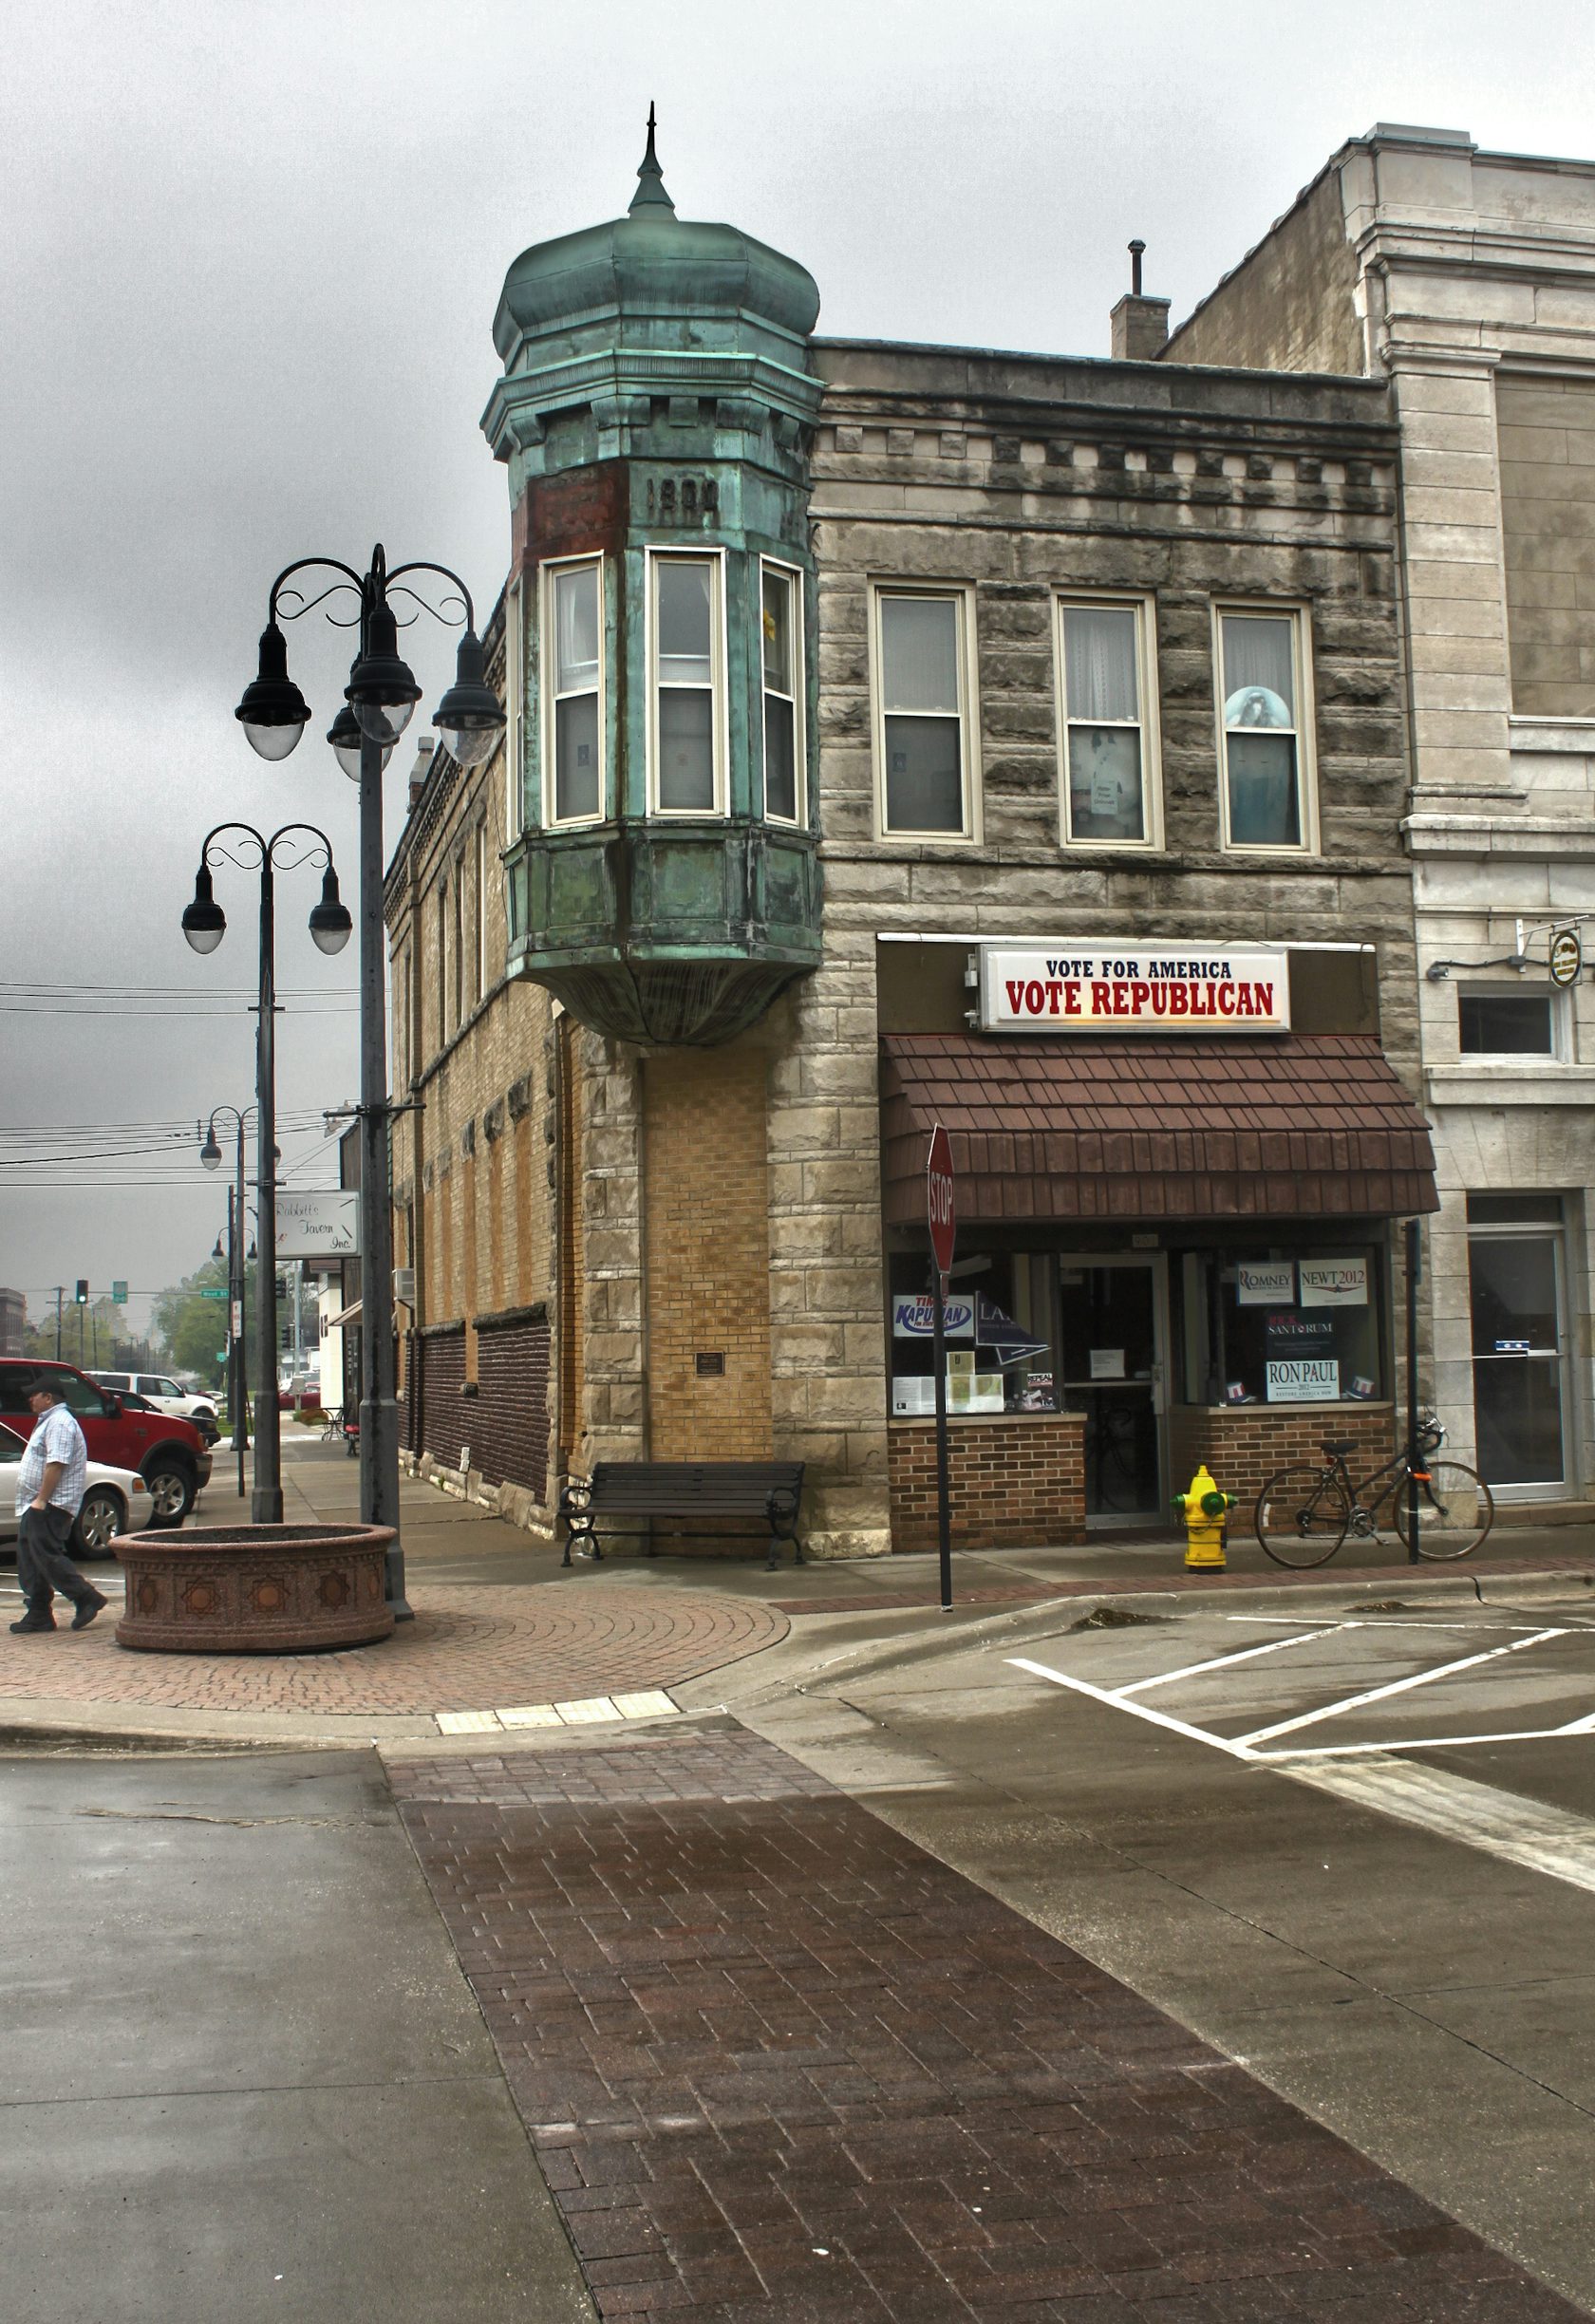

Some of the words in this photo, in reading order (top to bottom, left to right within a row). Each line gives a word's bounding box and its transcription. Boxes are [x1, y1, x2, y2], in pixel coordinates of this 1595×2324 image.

[1046, 961, 1093, 978] VOTE
[1101, 961, 1139, 978] FOR
[1148, 961, 1231, 979] AMERICA
[1005, 981, 1081, 1015] VOTE
[1091, 982, 1273, 1016] REPUBLICAN
[930, 1171, 953, 1226] STOP
[298, 1219, 333, 1234] Tavern
[1239, 1268, 1290, 1290] ROMNEY
[1302, 1270, 1338, 1285] NEWT
[1339, 1269, 1365, 1284] 2012
[1269, 1363, 1300, 1383] RON
[1302, 1361, 1337, 1382] PAUL
